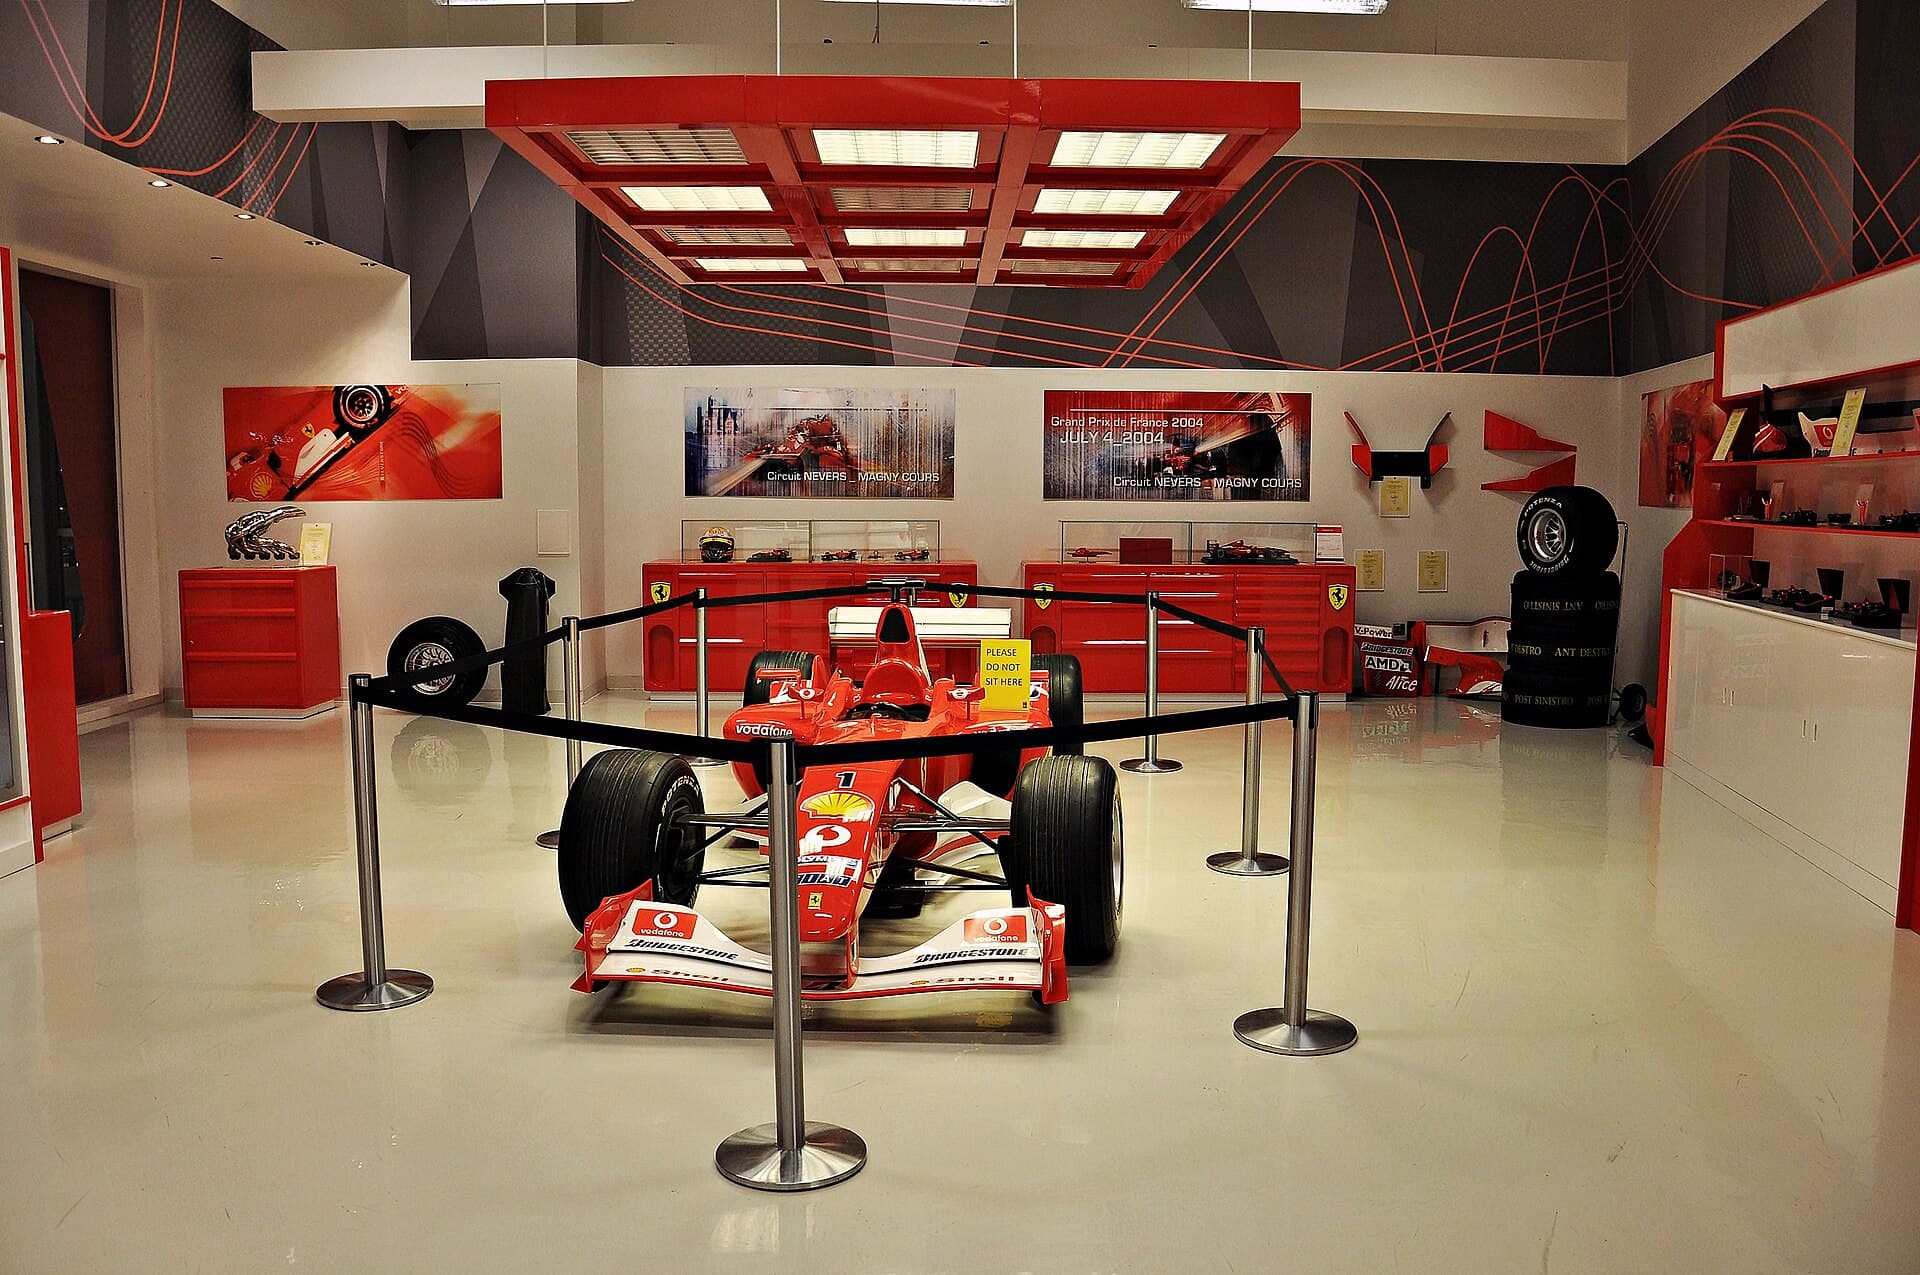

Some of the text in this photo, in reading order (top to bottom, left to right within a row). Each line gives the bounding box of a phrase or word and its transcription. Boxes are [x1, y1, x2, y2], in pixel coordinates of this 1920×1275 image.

[1051, 416, 1204, 428] Grand Prix de France 2004
[1060, 431, 1098, 444] JULY
[767, 471, 801, 481] Circuit
[803, 471, 847, 481] NEVERS
[858, 472, 899, 482] MAGNY
[902, 472, 940, 482] COURS
[1113, 476, 1151, 487] Circuit
[1154, 477, 1201, 487] NEVERS
[1214, 477, 1259, 488] MAGNY
[1261, 477, 1302, 488] COURS
[1524, 497, 1562, 517] POTENZA
[986, 648, 1017, 657] PLEASE
[1554, 647, 1577, 657] ANT
[986, 662, 1021, 671] DO NOT
[1365, 656, 1400, 672] AMD
[985, 677, 1023, 687] SIT HERE
[1385, 675, 1418, 692] Alice
[1515, 695, 1532, 704] POST
[1534, 695, 1575, 706] SINISTRO
[736, 724, 793, 736] vodafone
[836, 771, 857, 789] 1
[661, 775, 700, 818] POTENZA
[797, 873, 853, 887] IAT
[640, 928, 685, 938] vodafone
[974, 935, 1019, 943] vodafone
[624, 938, 739, 961] BRIDGESTONE
[913, 948, 1029, 964] BRIDGESTONE
[651, 968, 729, 982] Shell
